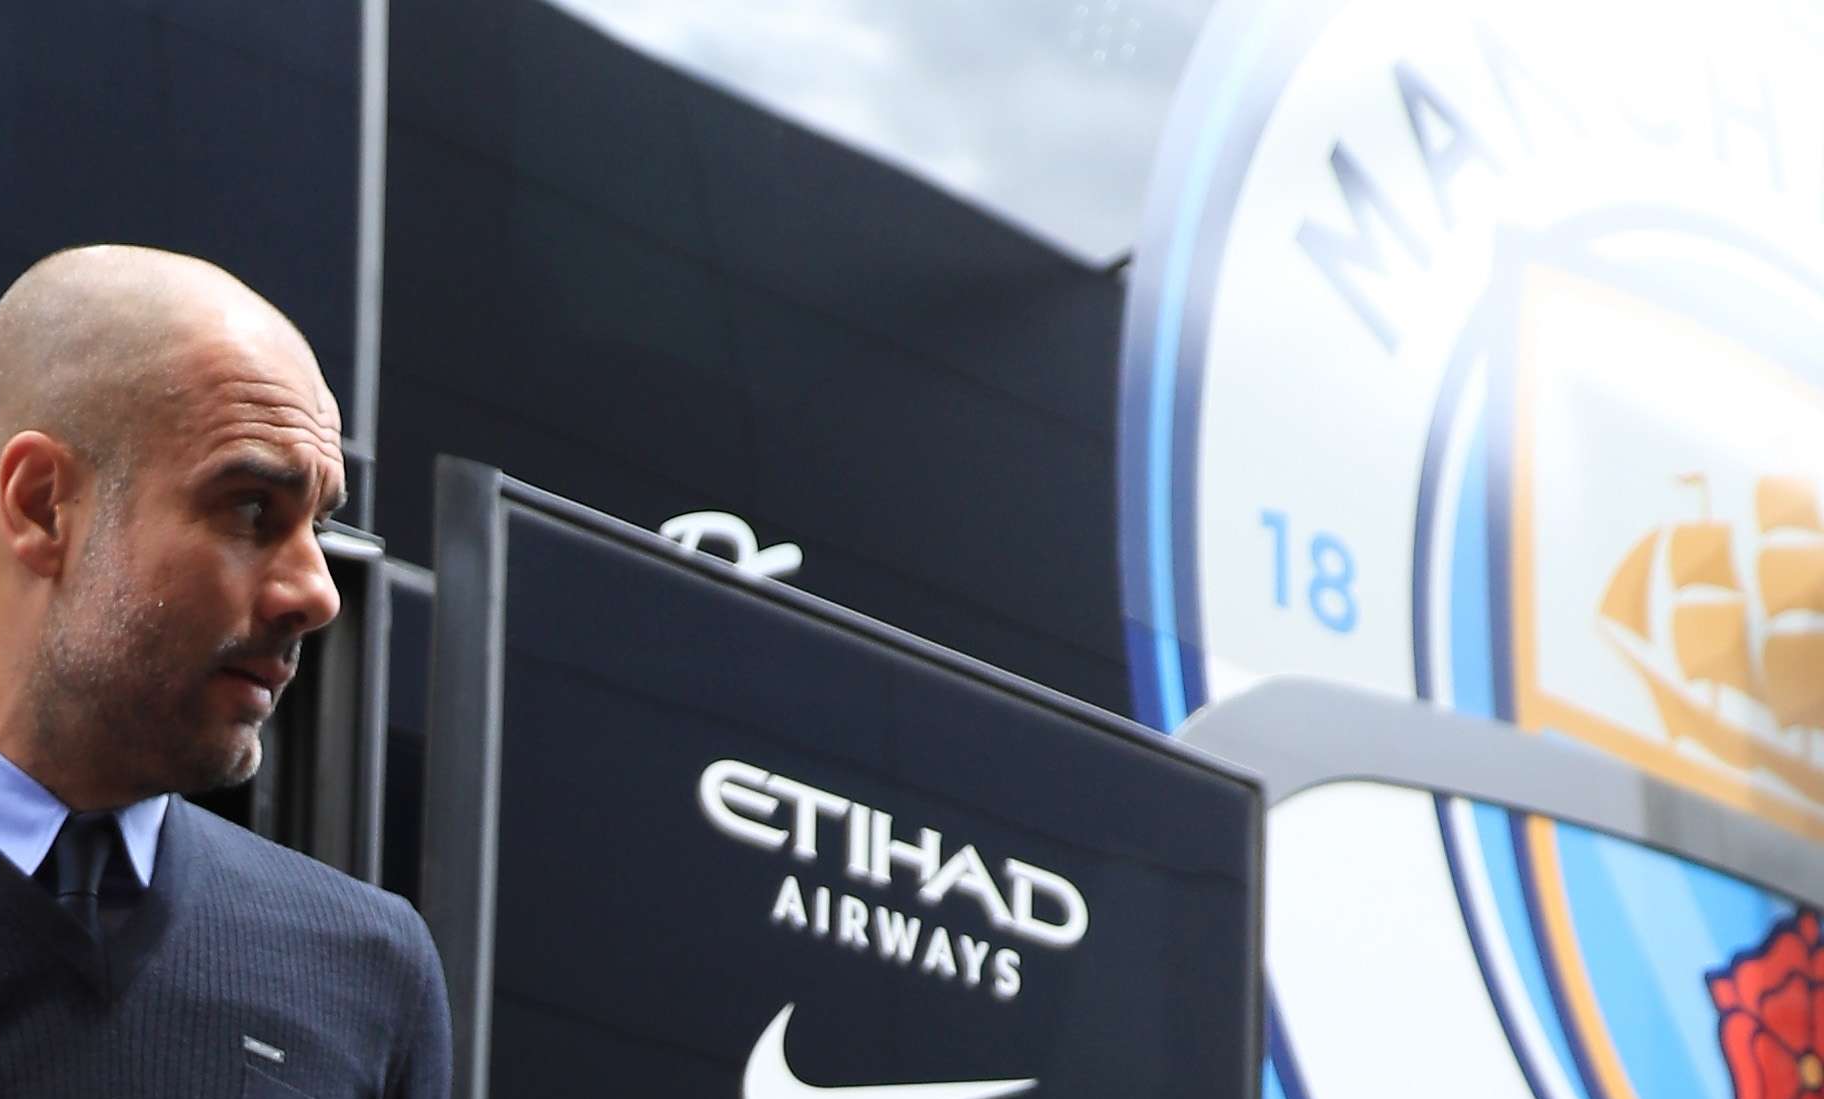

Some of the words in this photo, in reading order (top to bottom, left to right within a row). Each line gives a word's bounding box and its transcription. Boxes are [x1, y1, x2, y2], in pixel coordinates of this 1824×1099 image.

[1294, 16, 1824, 357] MANH
[1260, 507, 1359, 635] 18
[699, 759, 1089, 946] ETIHAD
[771, 875, 1022, 999] AIRWAYS
